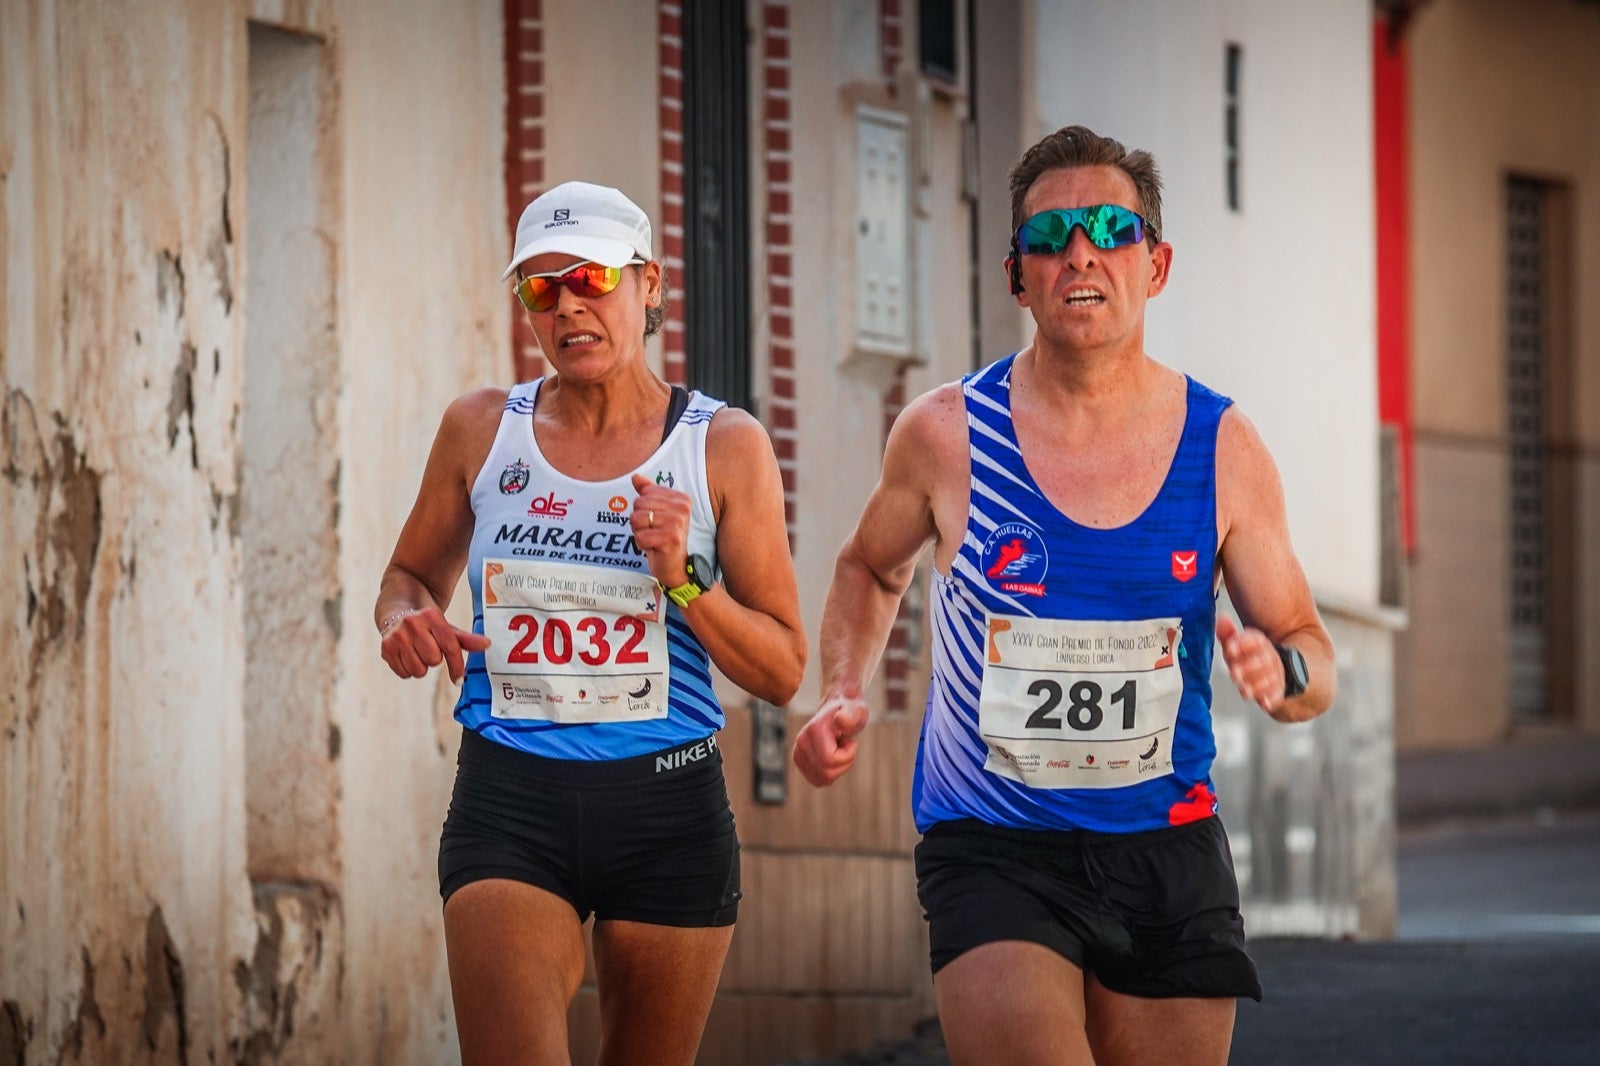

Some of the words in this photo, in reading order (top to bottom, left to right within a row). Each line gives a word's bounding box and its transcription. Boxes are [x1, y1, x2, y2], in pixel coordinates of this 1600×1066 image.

[494, 523, 648, 558] MARACEN
[995, 525, 1033, 540] HUELLAS
[512, 547, 545, 557] CLUB
[549, 550, 565, 560] DE
[569, 553, 642, 569] ATLETISMO
[504, 574, 524, 588] XXXV
[527, 575, 547, 590] GRAN
[550, 576, 577, 593] PREMIO
[592, 579, 617, 597] FONDO
[620, 584, 643, 600] 2022
[507, 614, 649, 666] 2032
[1012, 632, 1034, 647] XXXV
[1037, 634, 1058, 649] GRAN
[1061, 635, 1092, 650] PREMIO
[1108, 636, 1135, 650] FONDO
[1138, 633, 1158, 650] 2022
[1056, 652, 1090, 665] UNIVERSO
[1092, 652, 1115, 664] LORCA
[1025, 679, 1136, 731] 281
[655, 742, 708, 773] NIKE
